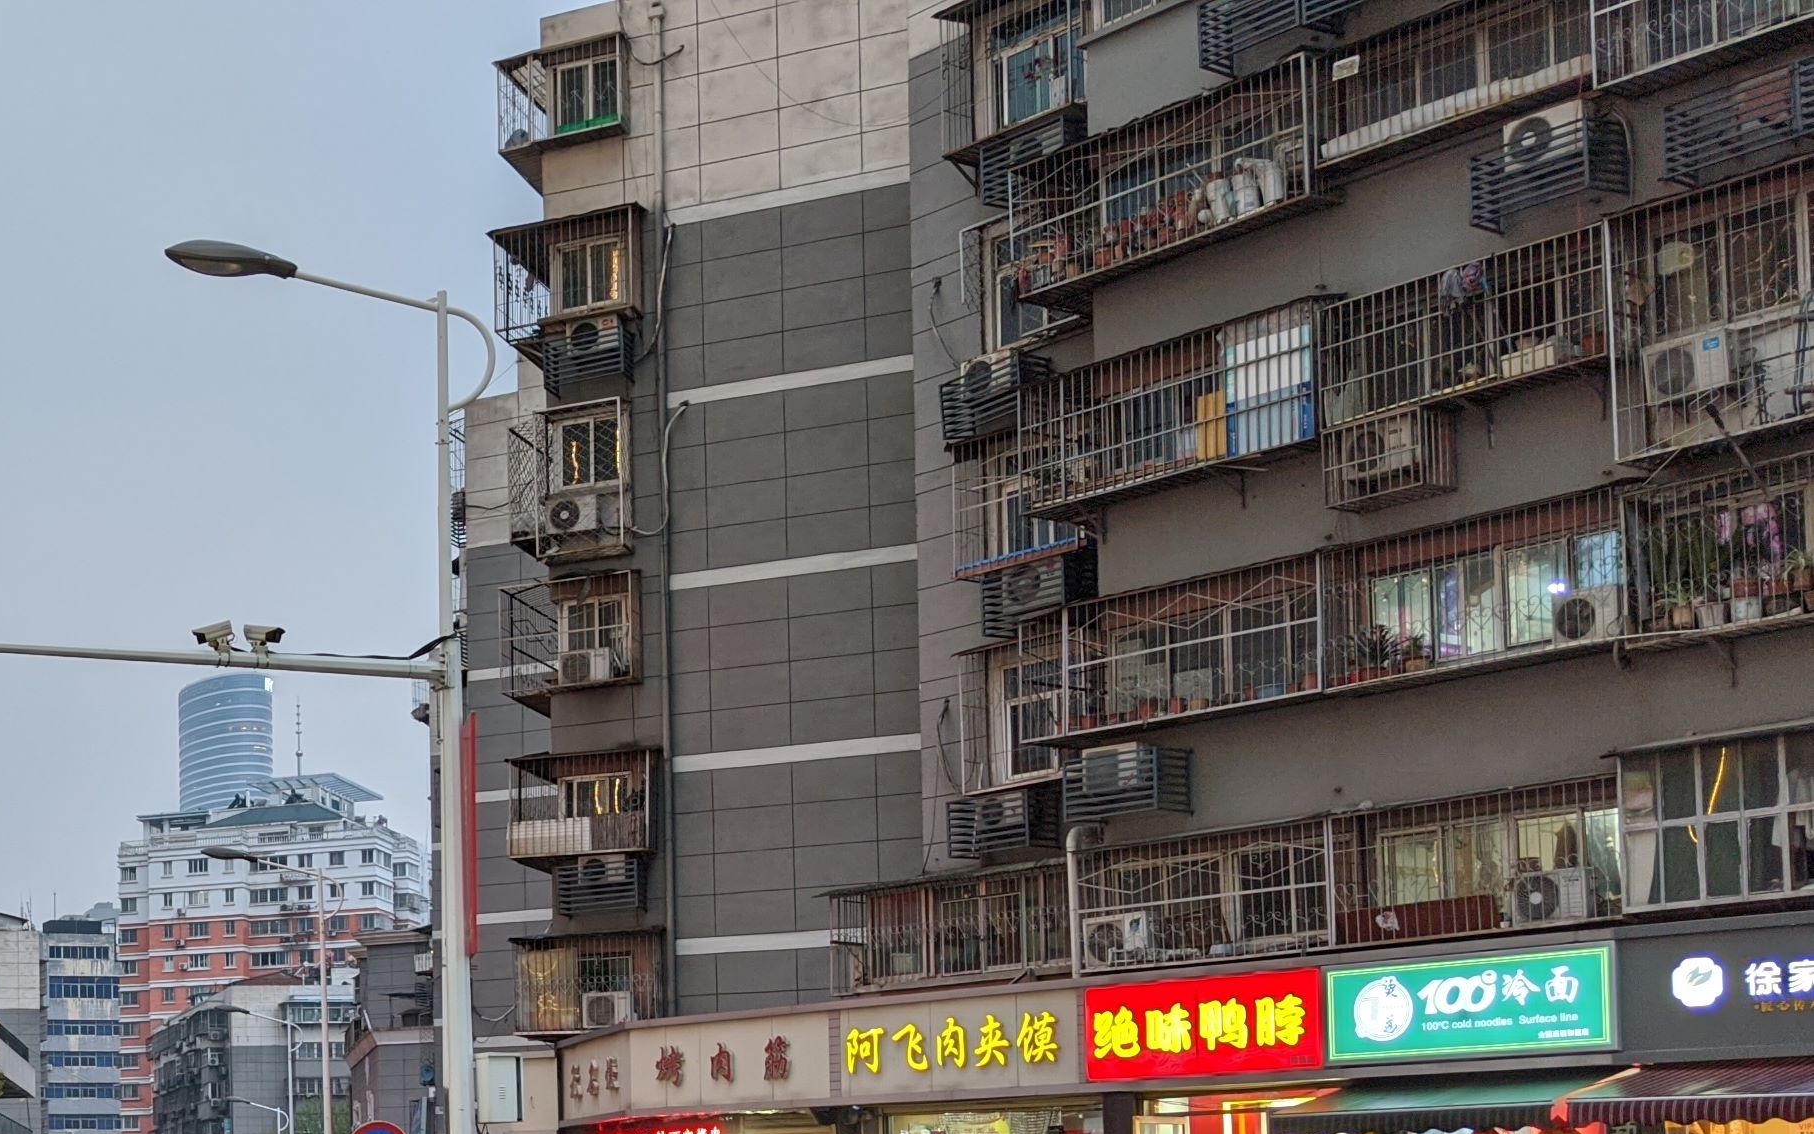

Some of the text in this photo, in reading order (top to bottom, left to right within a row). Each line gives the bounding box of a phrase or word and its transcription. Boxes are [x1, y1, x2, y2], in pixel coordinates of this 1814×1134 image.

[846, 1011, 1059, 1074] 阿飞肉夹馍
[1093, 993, 1306, 1059] 绝味鸭脖
[1451, 1018, 1472, 1030] cold
[1474, 1016, 1513, 1029] noodles
[1518, 1012, 1556, 1026] Surface
[1560, 1011, 1579, 1022] line
[655, 1035, 791, 1088] 烤肉筋
